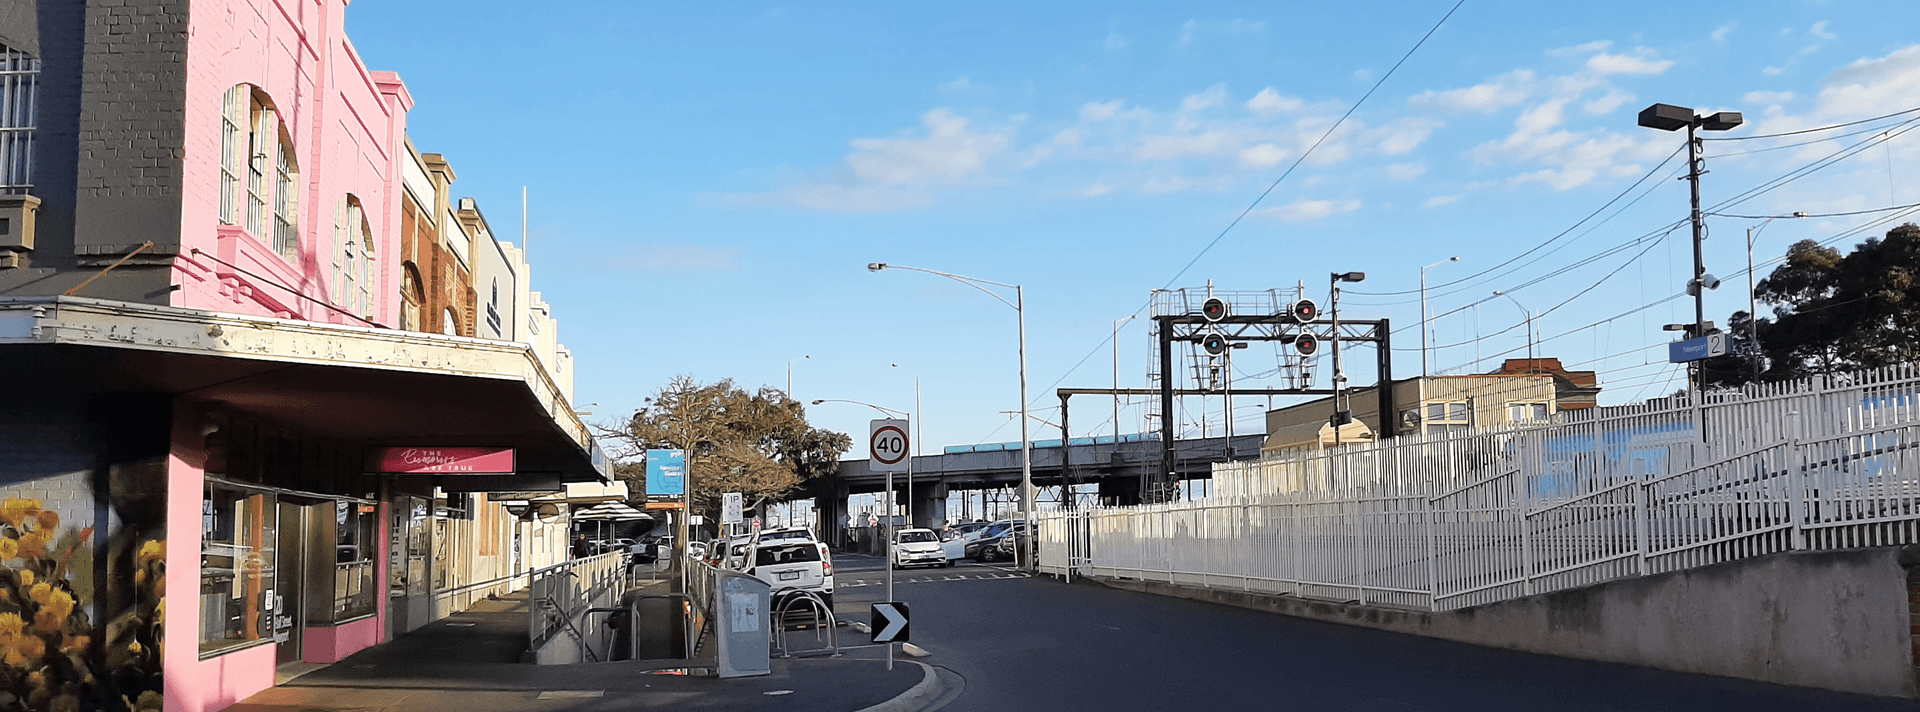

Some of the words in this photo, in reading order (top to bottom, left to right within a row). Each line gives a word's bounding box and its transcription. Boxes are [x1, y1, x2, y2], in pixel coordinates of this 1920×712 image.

[1682, 343, 1707, 354] Newport
[1711, 336, 1721, 354] 2
[876, 436, 902, 454] 40
